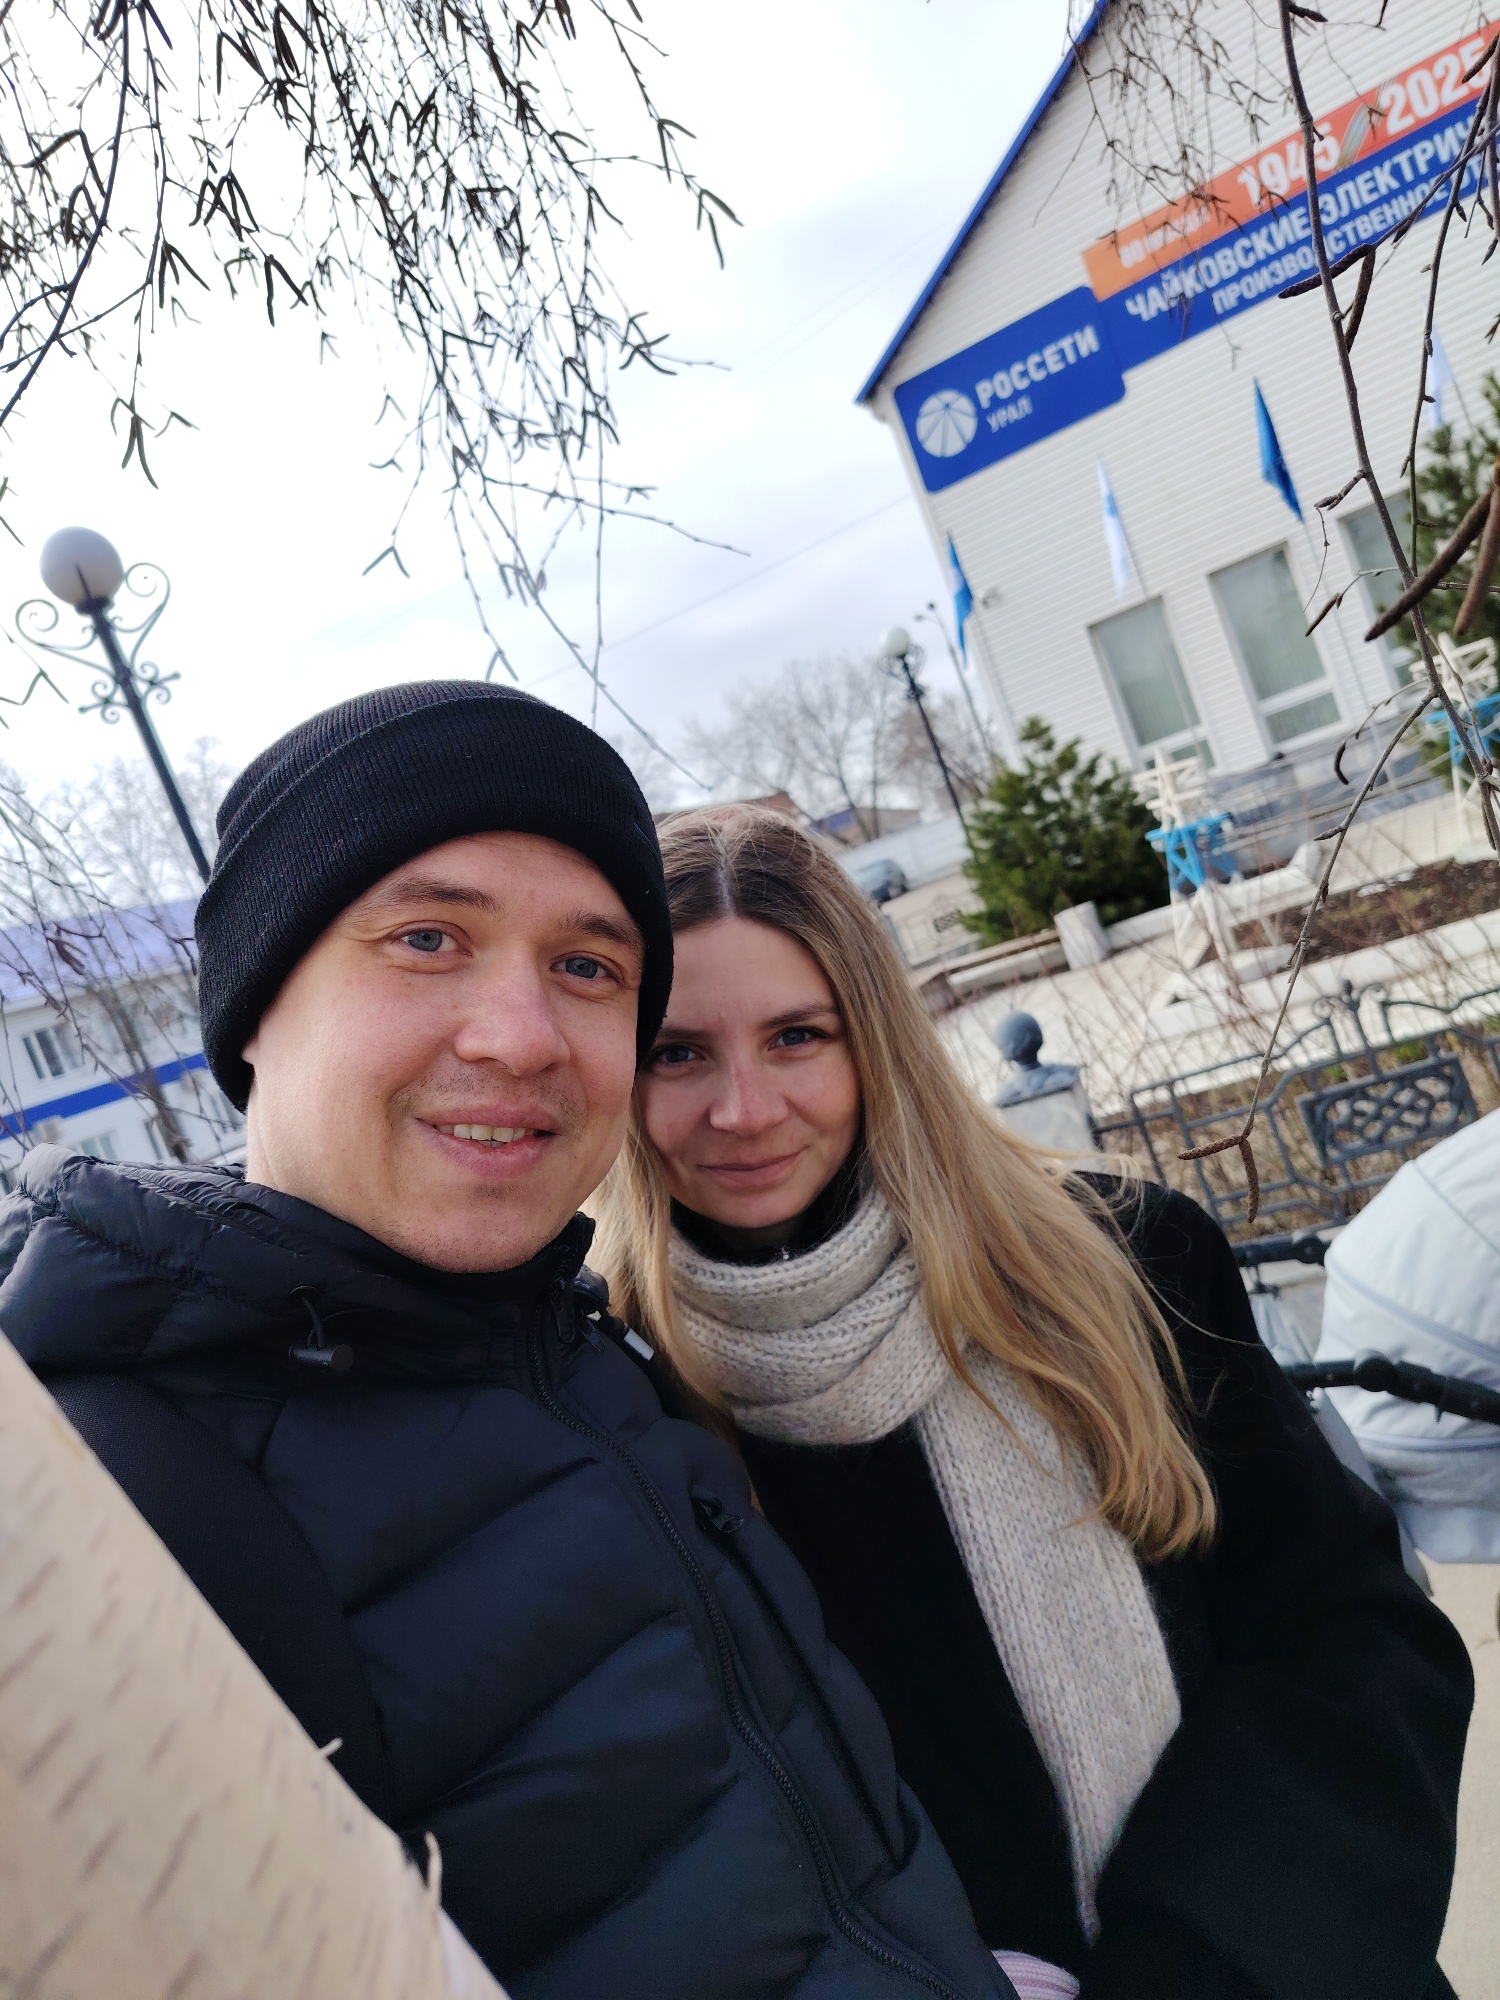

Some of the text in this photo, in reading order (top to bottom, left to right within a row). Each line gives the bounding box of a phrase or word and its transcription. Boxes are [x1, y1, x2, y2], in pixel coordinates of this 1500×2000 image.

[1237, 122, 1340, 209] 1945
[1379, 36, 1493, 136] 2025
[1125, 205, 1313, 321] ЧАЙКОВСКИЕ
[1318, 103, 1500, 227] ЭЛЕКТРИЧ
[975, 324, 1101, 409] РОССЕТИ
[986, 394, 1033, 433] УРАЛ
